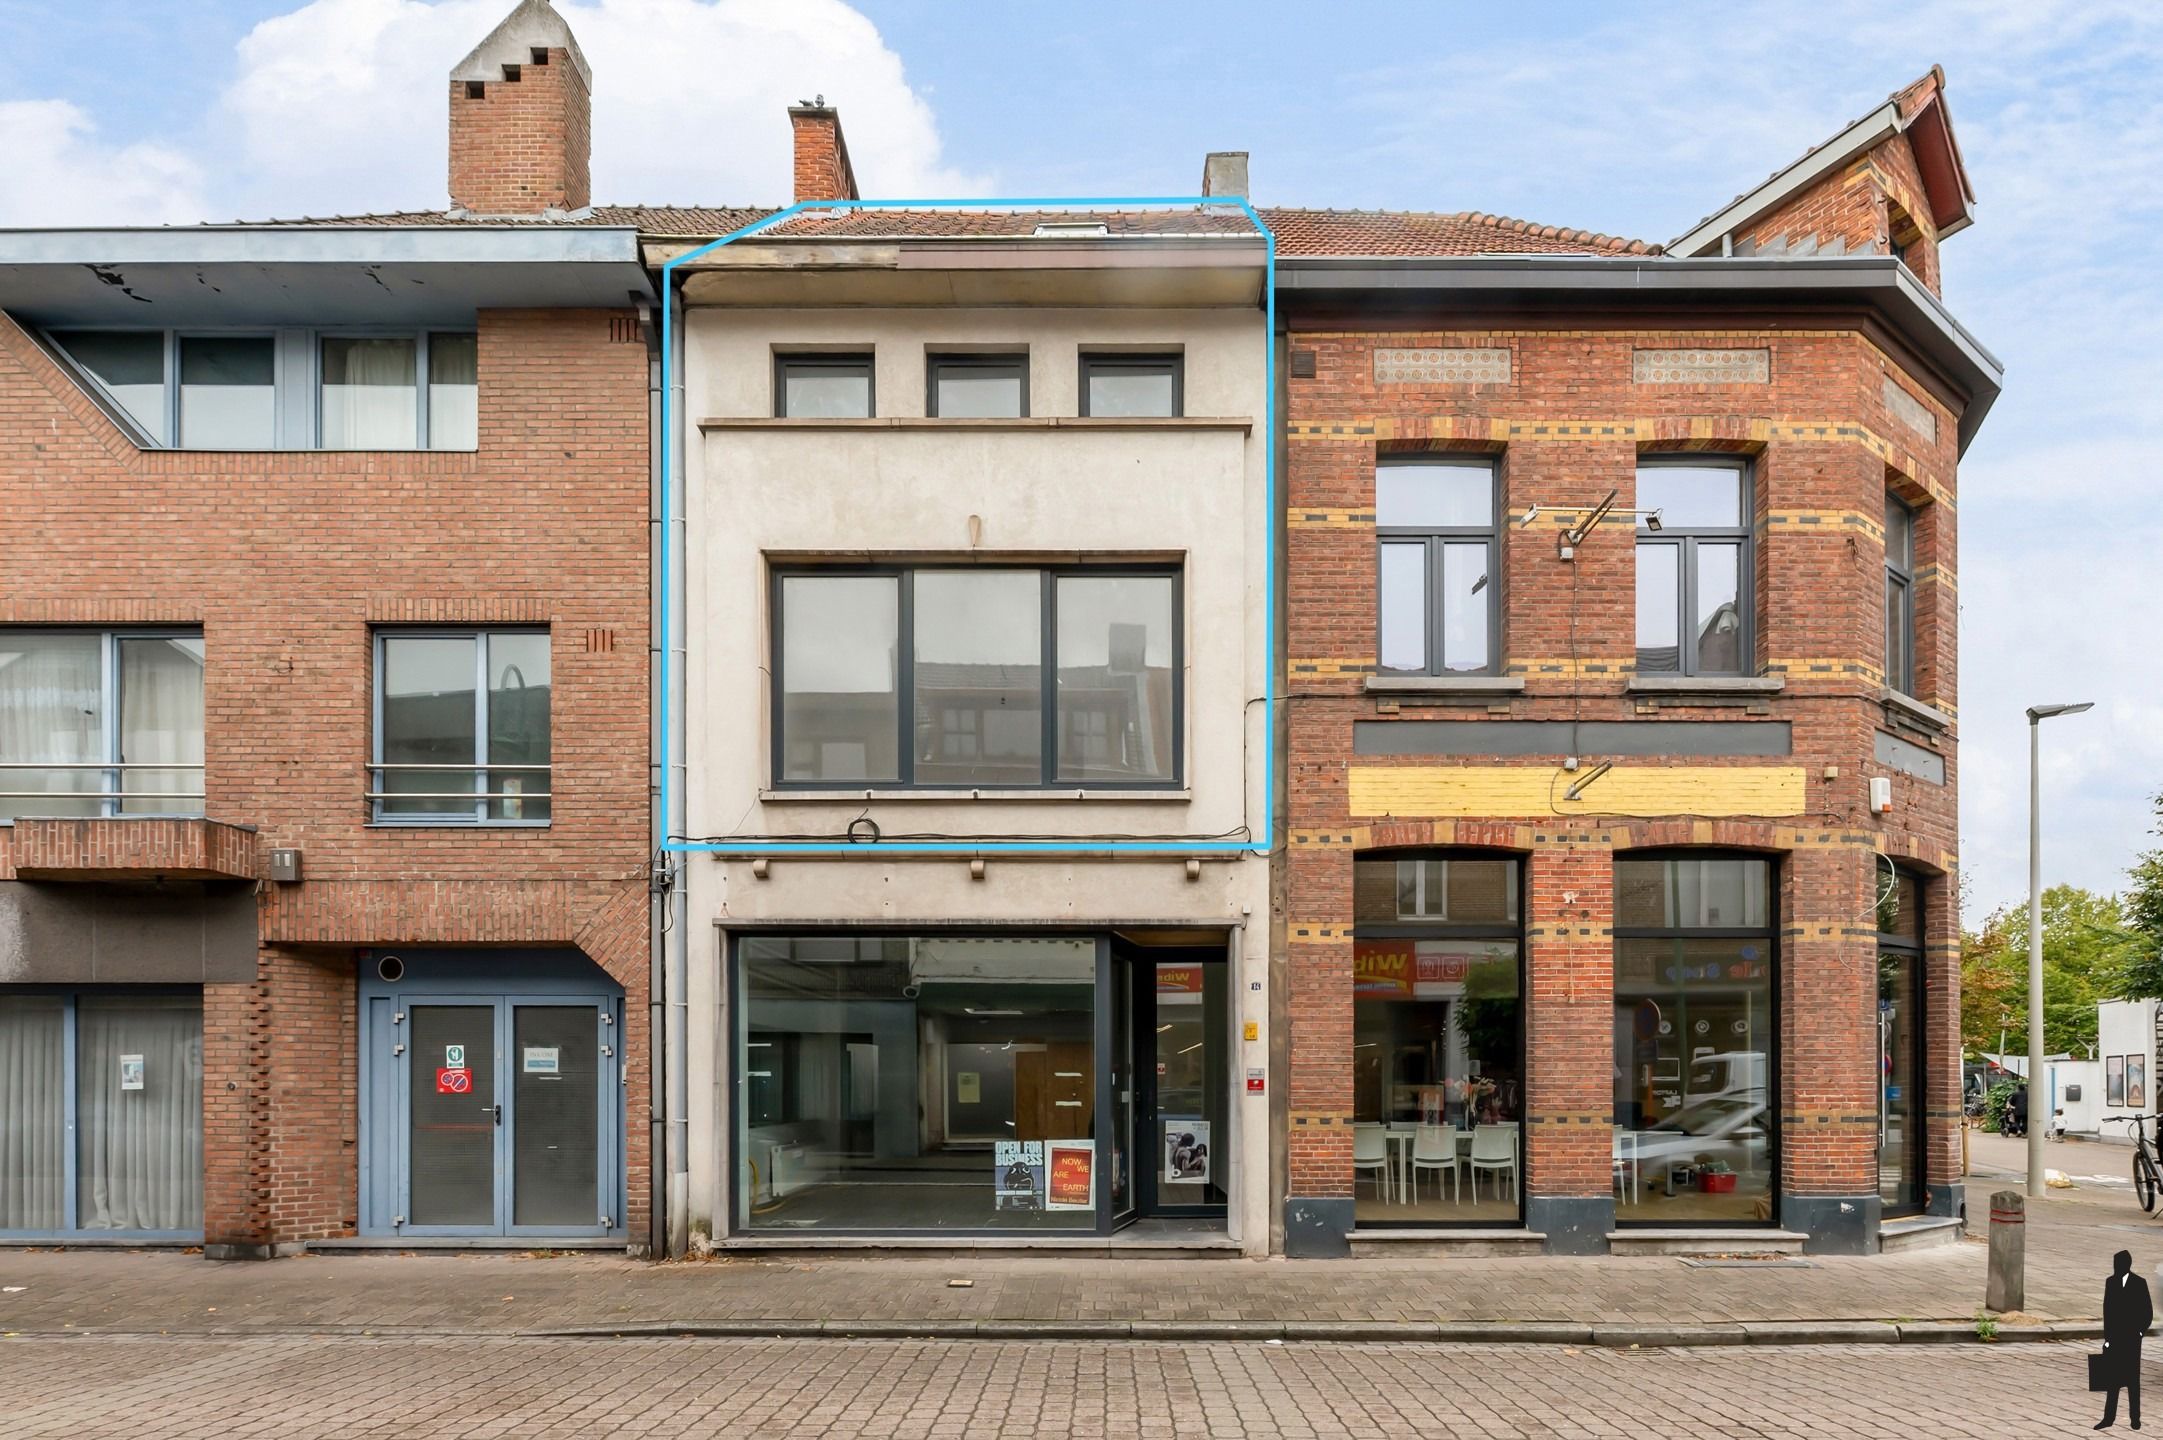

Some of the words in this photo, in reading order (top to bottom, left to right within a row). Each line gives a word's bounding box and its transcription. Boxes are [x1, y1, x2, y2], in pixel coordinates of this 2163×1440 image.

[995, 1141, 1020, 1154] OPEN
[1024, 1141, 1042, 1154] FOR
[995, 1153, 1043, 1166] BUSINESS
[1077, 1165, 1089, 1173] WE
[1062, 1184, 1089, 1192] EARTH
